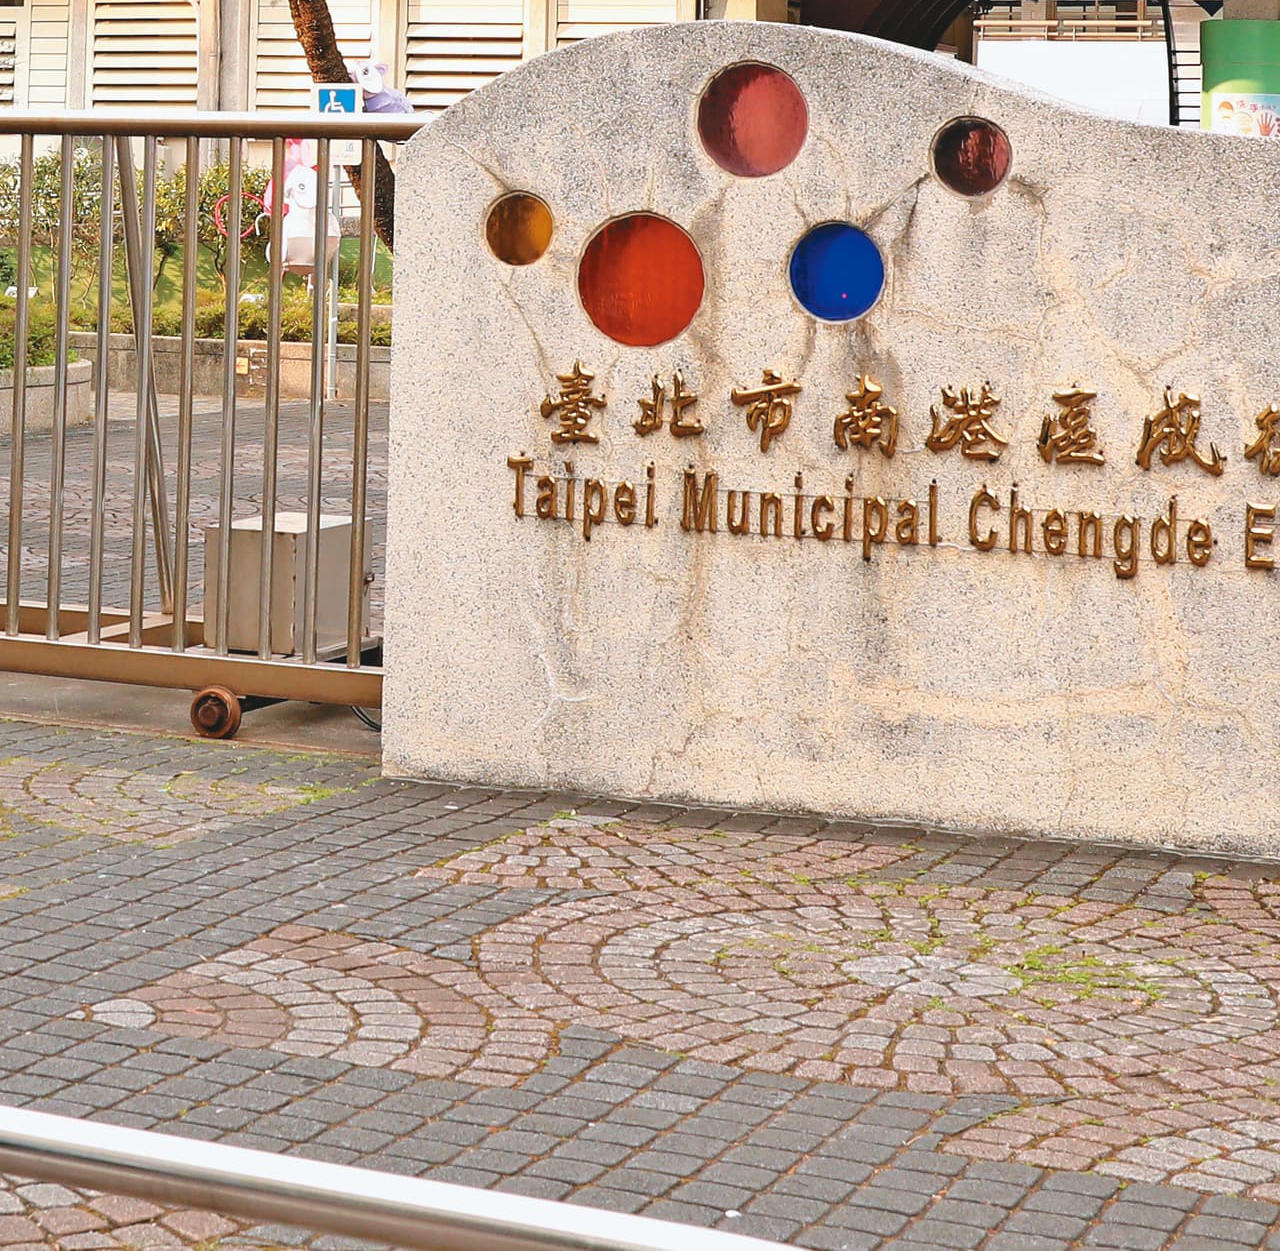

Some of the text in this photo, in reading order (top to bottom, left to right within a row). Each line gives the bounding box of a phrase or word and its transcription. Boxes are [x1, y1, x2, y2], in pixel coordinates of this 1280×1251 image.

[507, 452, 658, 541] Taipei
[680, 464, 938, 562] Municipal
[969, 480, 1213, 579] Chengde
